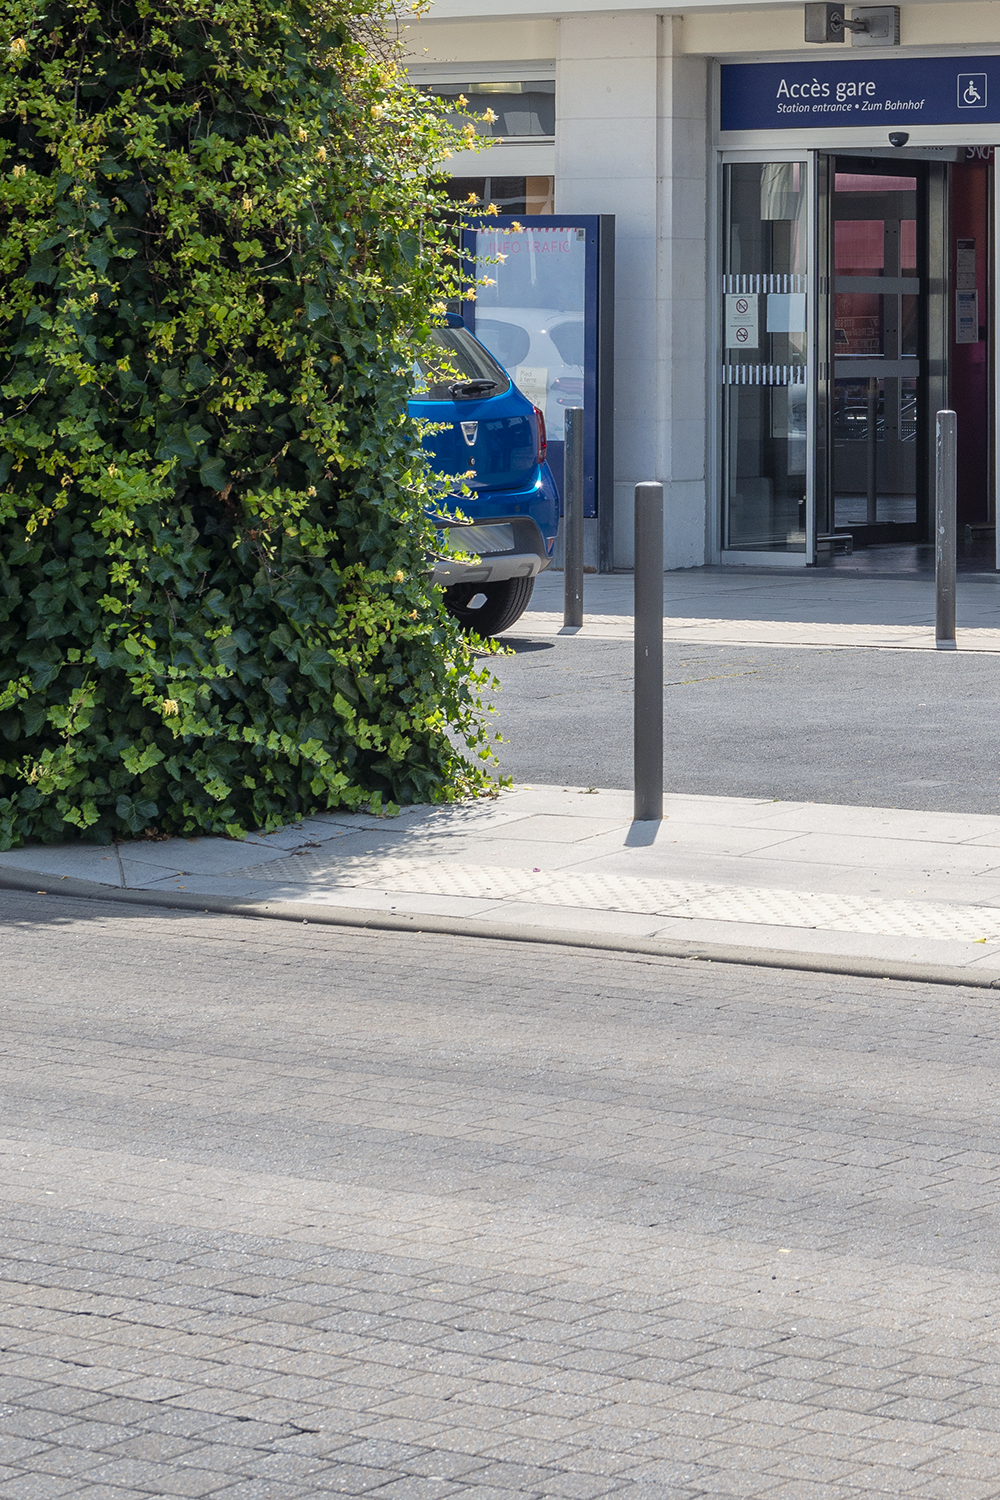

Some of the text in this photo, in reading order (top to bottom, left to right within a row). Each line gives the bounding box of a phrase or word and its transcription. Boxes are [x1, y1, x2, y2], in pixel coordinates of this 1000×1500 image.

[776, 78, 876, 102] Accès gare
[776, 99, 926, 114] Station entrance Zum Bahnhof
[488, 240, 571, 254] INFO TRAFIC
